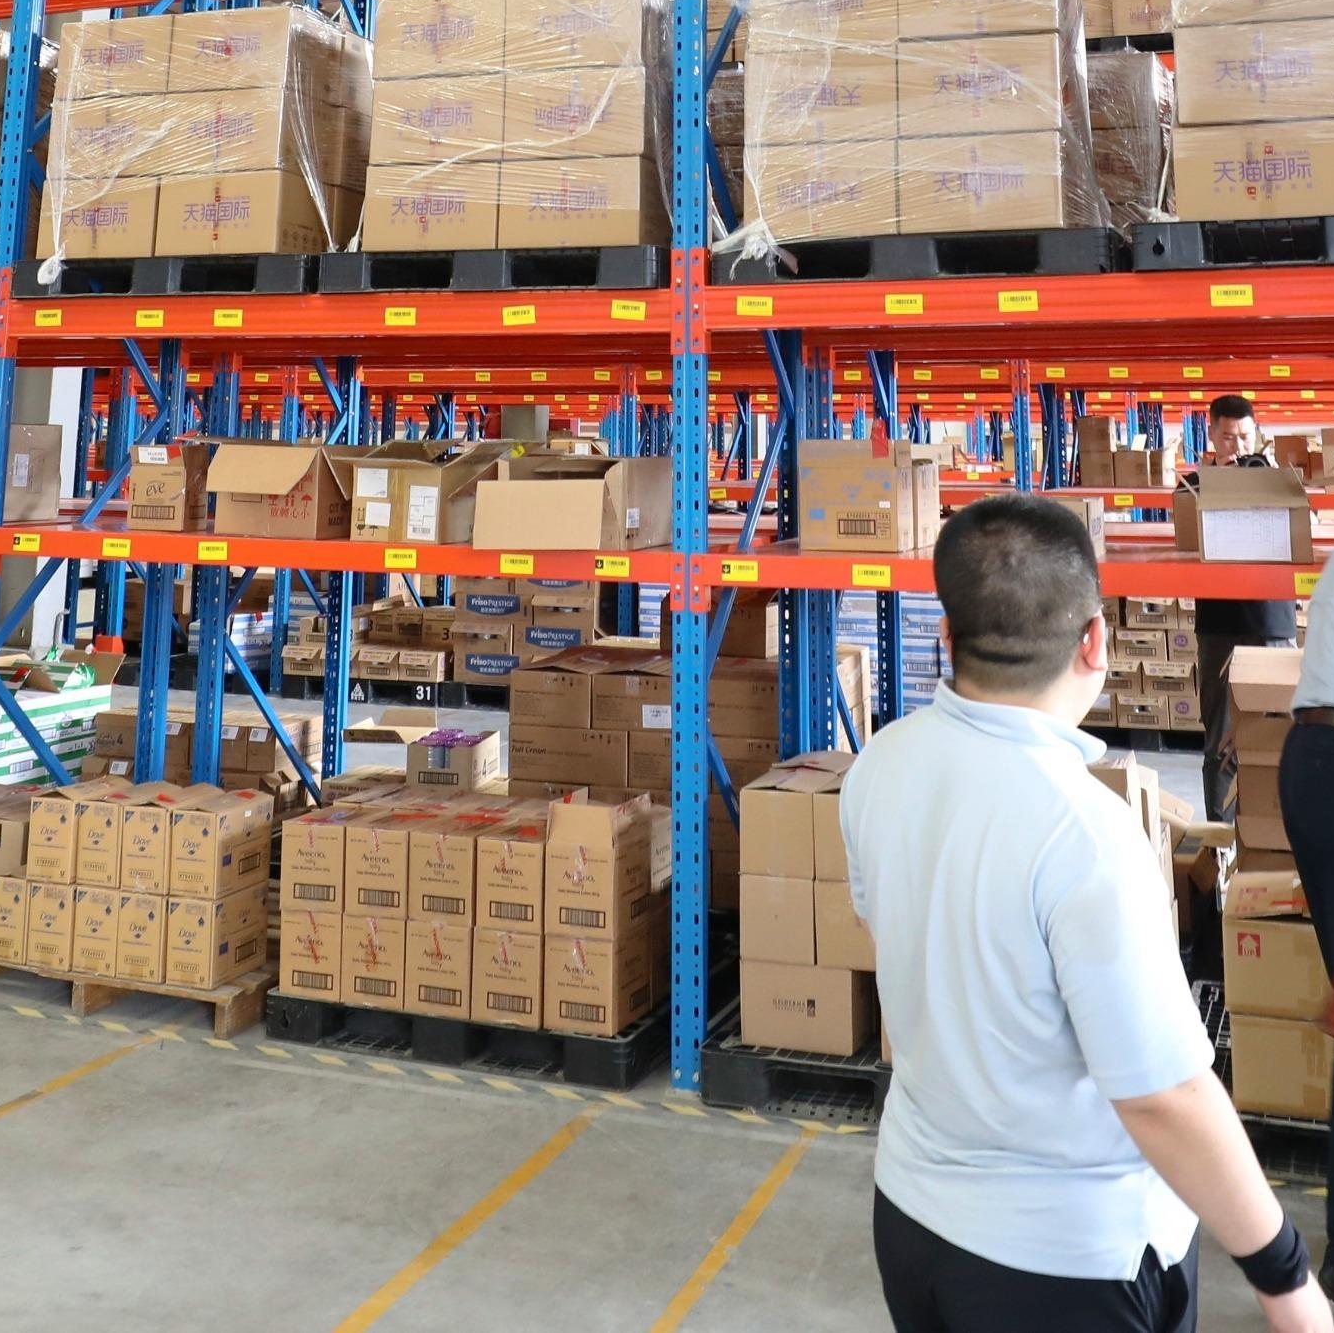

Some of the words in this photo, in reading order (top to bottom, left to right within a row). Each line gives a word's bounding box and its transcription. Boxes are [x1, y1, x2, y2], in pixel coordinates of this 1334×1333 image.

[1213, 156, 1312, 183] 天猫国际
[391, 193, 465, 216] 天猫国际
[64, 204, 129, 228] 天猫国际
[183, 201, 251, 223] 天猫国际
[415, 685, 431, 701] 31
[40, 826, 58, 835] Dove
[87, 829, 105, 839] Dove
[132, 835, 150, 845] Dove
[182, 839, 201, 849] Dove
[40, 912, 57, 922] Dove
[85, 917, 103, 927] Dove
[129, 923, 147, 933] Dove
[178, 929, 197, 939] Dove
